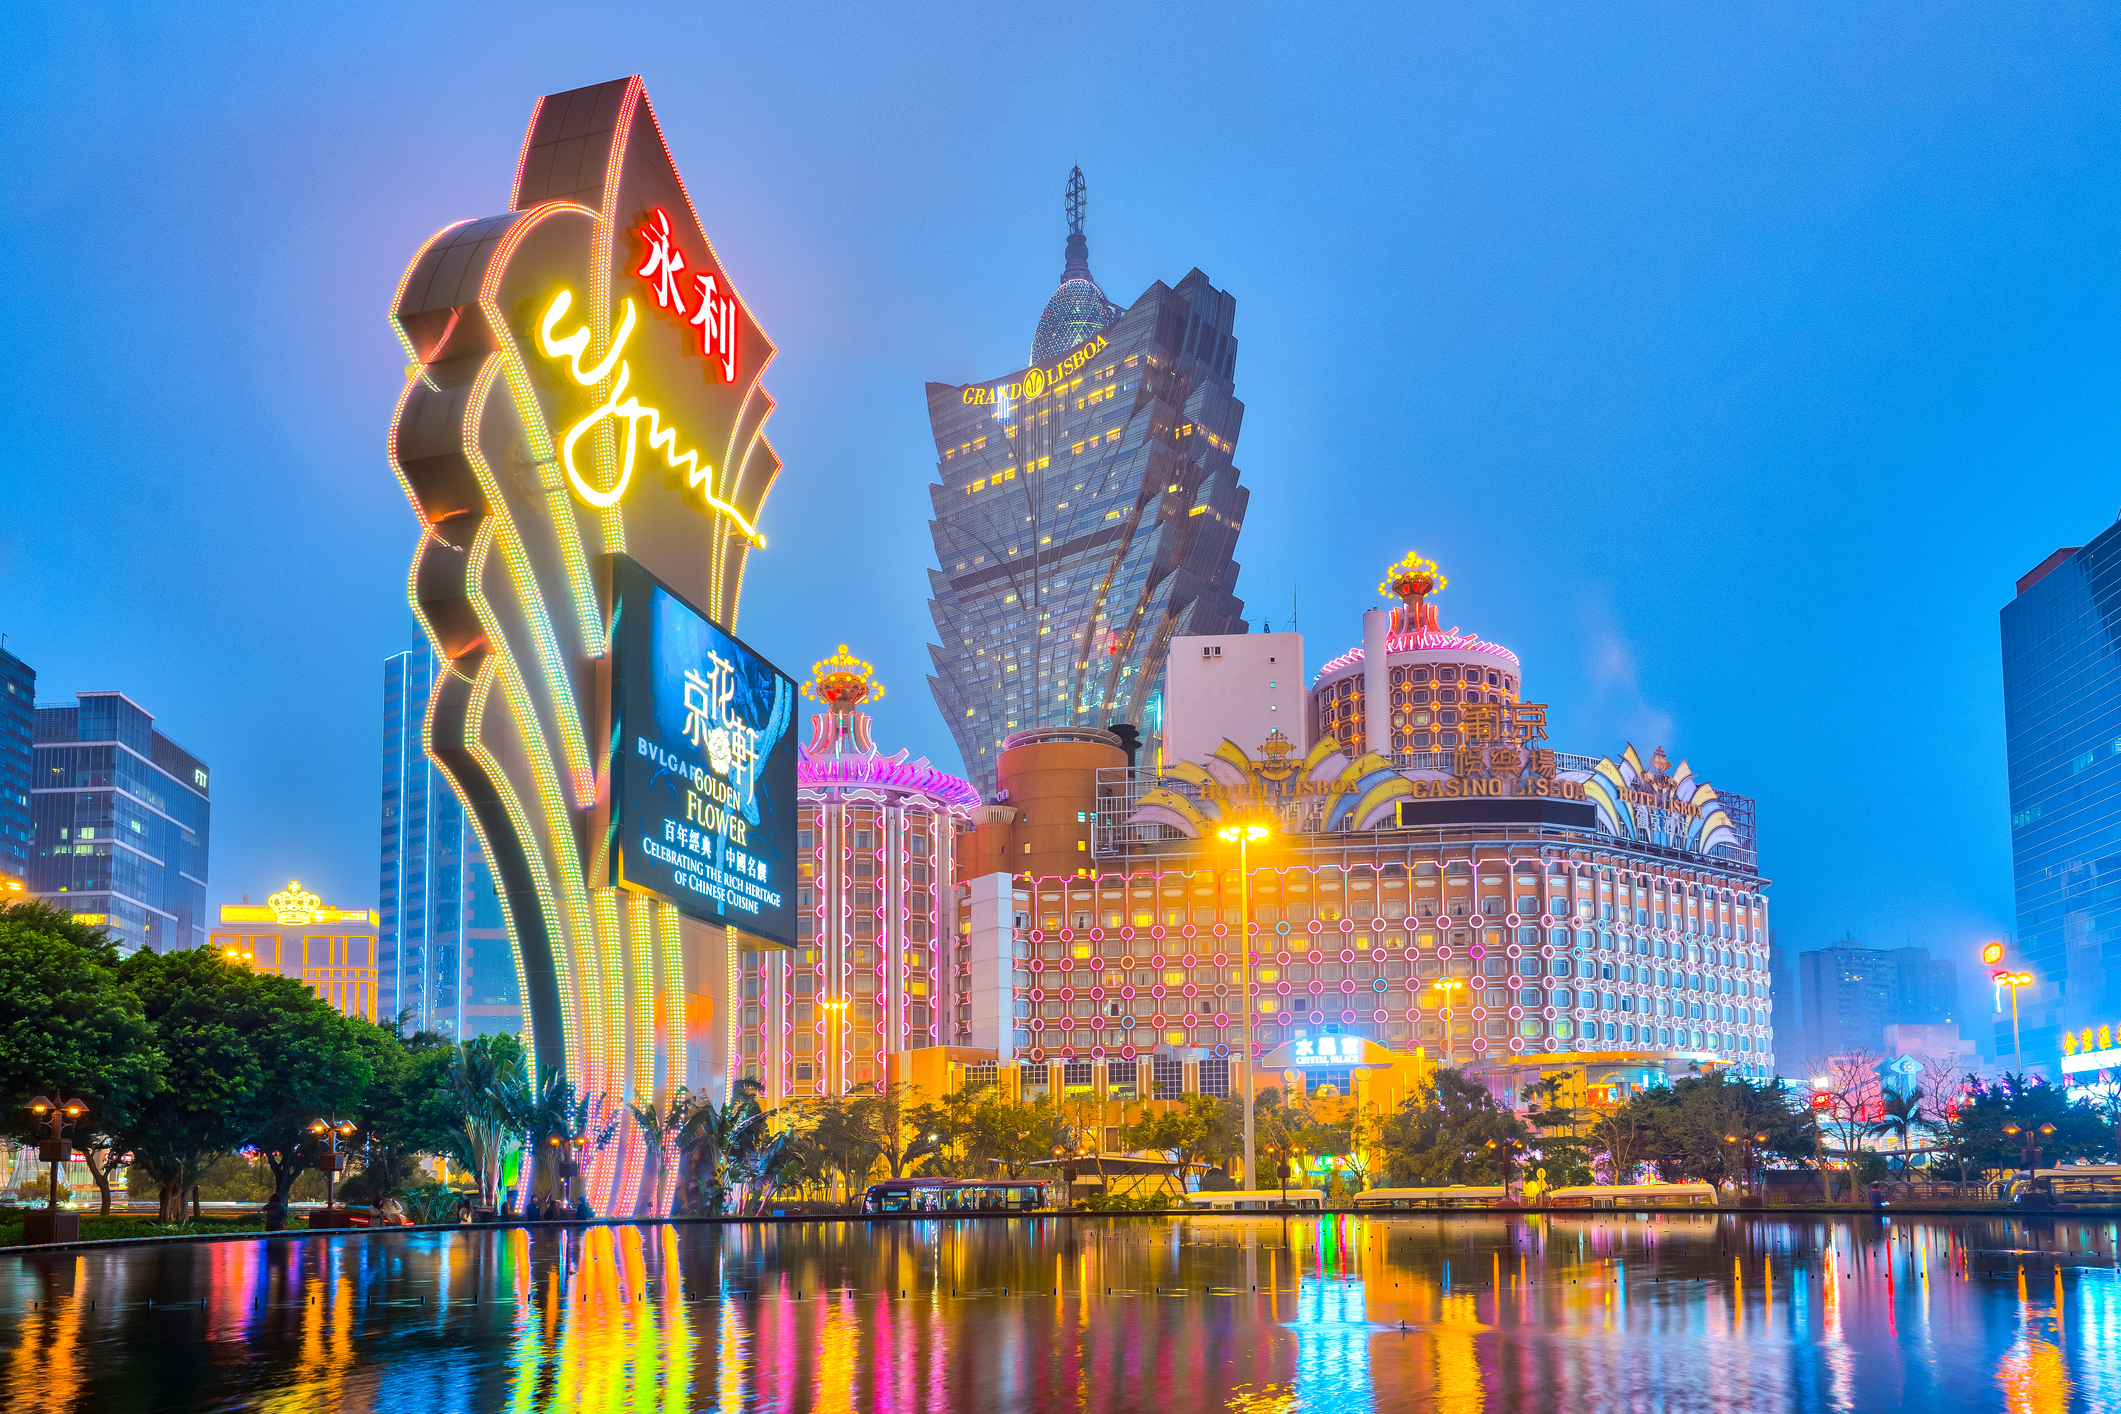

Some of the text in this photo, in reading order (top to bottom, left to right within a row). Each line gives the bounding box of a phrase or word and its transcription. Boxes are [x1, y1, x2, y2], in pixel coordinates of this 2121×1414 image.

[638, 207, 737, 383] 永利
[962, 334, 1110, 406] GRAND LISBOA
[534, 288, 767, 550] Wynn
[1460, 700, 1549, 742] 葡京
[637, 736, 703, 781] BVLGAR
[694, 766, 741, 812] GOLDEN
[1200, 778, 1362, 800] HOTEL LISBOA
[1412, 776, 1587, 801] CASINO LISBOA
[1618, 785, 1705, 820] HOTEL LISBOA
[686, 789, 748, 847] FLOWER
[674, 870, 759, 914] OF CHINESE CUISINE
[704, 864, 723, 884] THE
[723, 872, 744, 893] RICH
[745, 880, 781, 908] HERITAGE
[1330, 1054, 1360, 1064] PALACE
